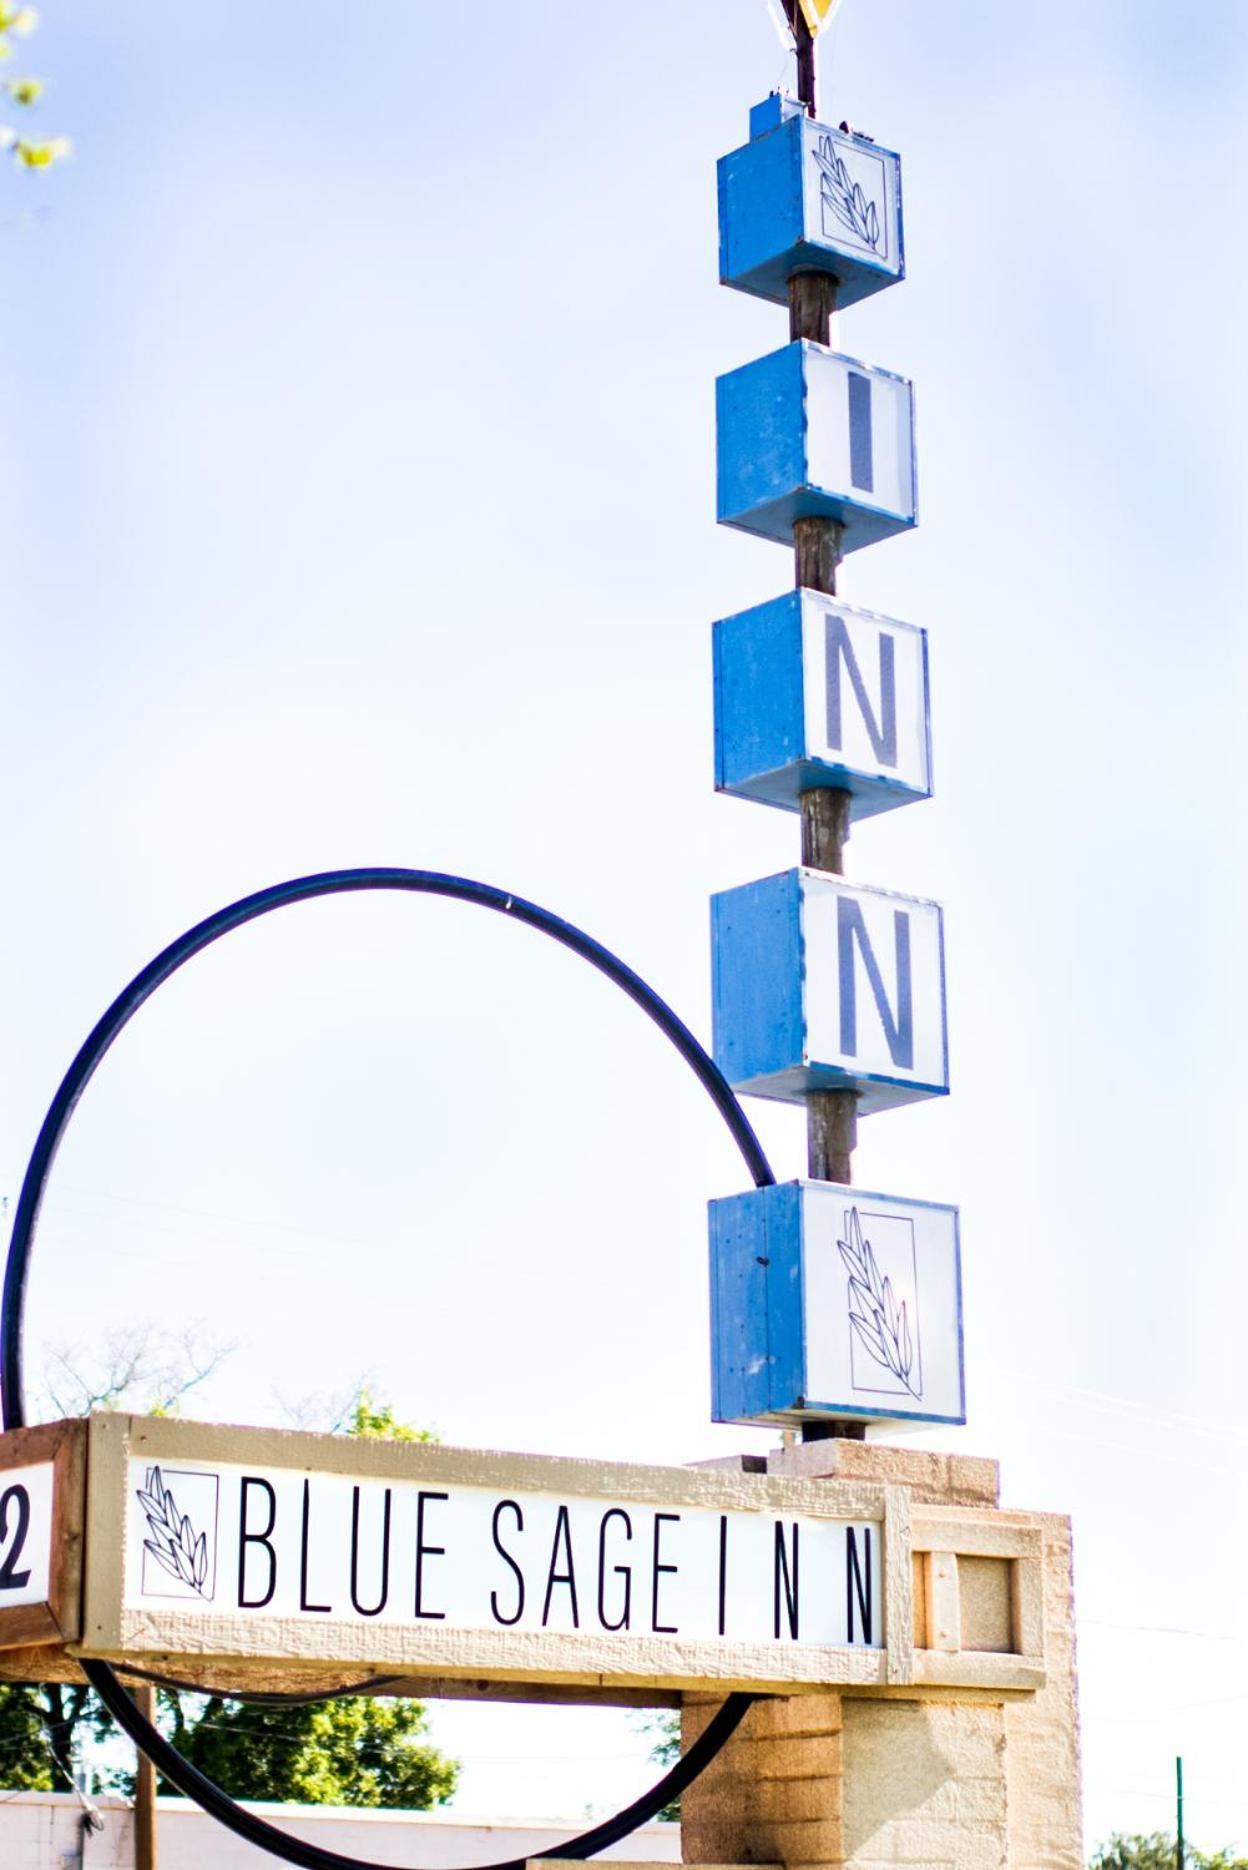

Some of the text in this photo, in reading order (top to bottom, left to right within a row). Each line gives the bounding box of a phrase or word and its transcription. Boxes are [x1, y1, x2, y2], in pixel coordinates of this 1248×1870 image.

[825, 371, 914, 1070] INN
[0, 1483, 32, 1590] 2
[238, 1475, 873, 1645] BLUE SAGE INN
